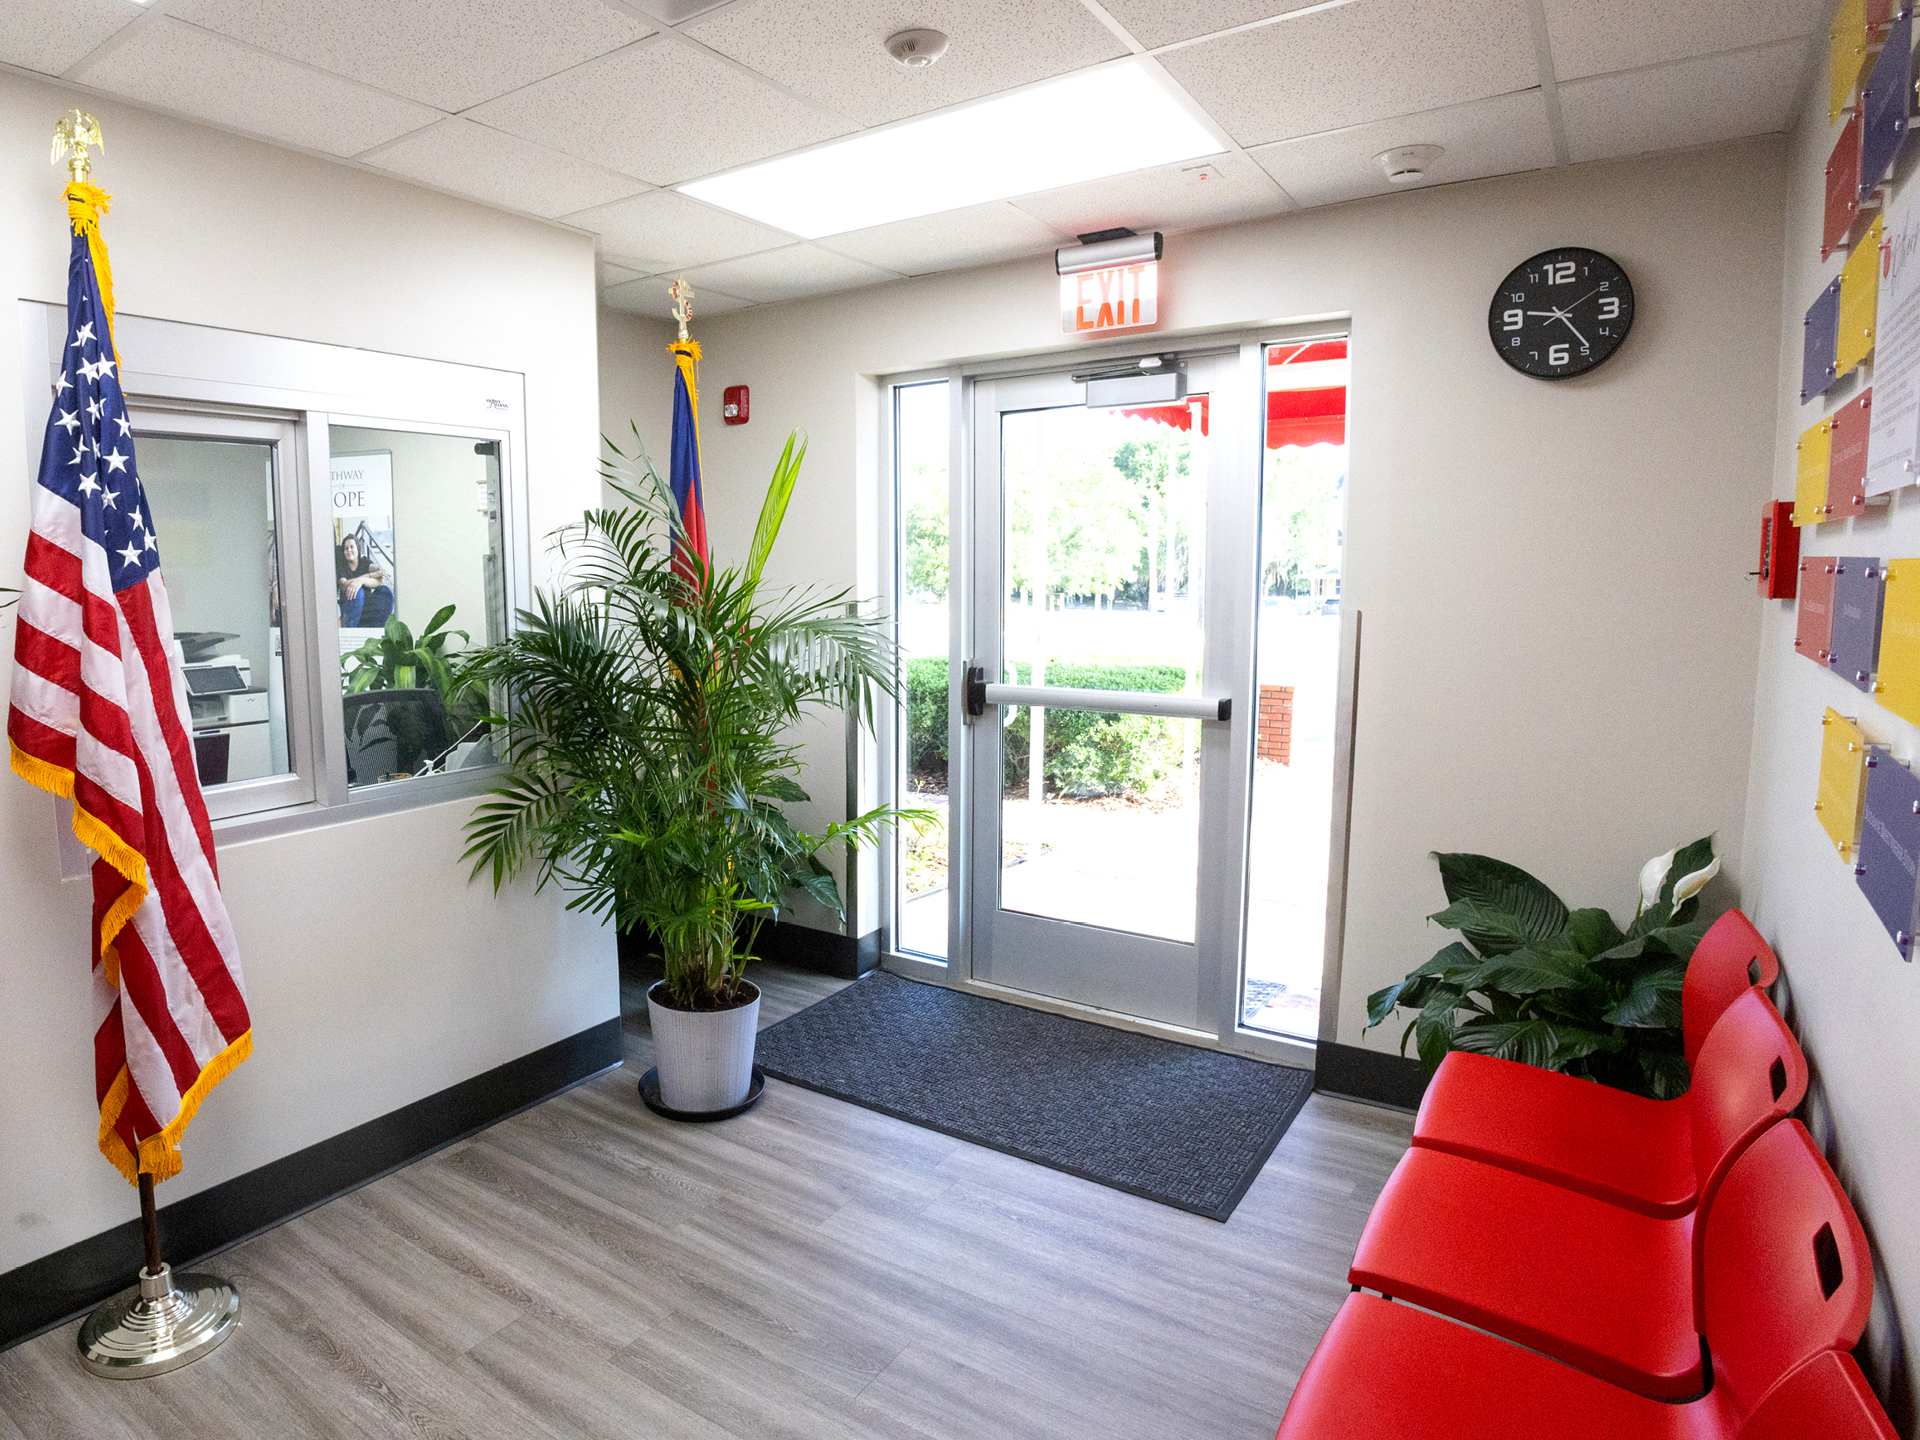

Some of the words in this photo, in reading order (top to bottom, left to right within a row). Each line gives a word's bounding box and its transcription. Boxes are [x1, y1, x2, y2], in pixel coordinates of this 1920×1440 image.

[1542, 261, 1576, 285] 12
[1583, 266, 1588, 276] 1
[1529, 273, 1539, 283] 11
[1600, 281, 1609, 291] 2
[1076, 265, 1145, 330] EXIT
[1511, 292, 1525, 303] 10
[1598, 297, 1620, 320] 3
[1503, 308, 1523, 331] 9
[1599, 327, 1609, 336] 4
[1511, 336, 1521, 347] 8
[1529, 351, 1538, 360] 7
[1548, 343, 1570, 366] 6
[1580, 346, 1590, 356] 5
[331, 469, 365, 481] THWAY
[333, 490, 365, 508] OPE
